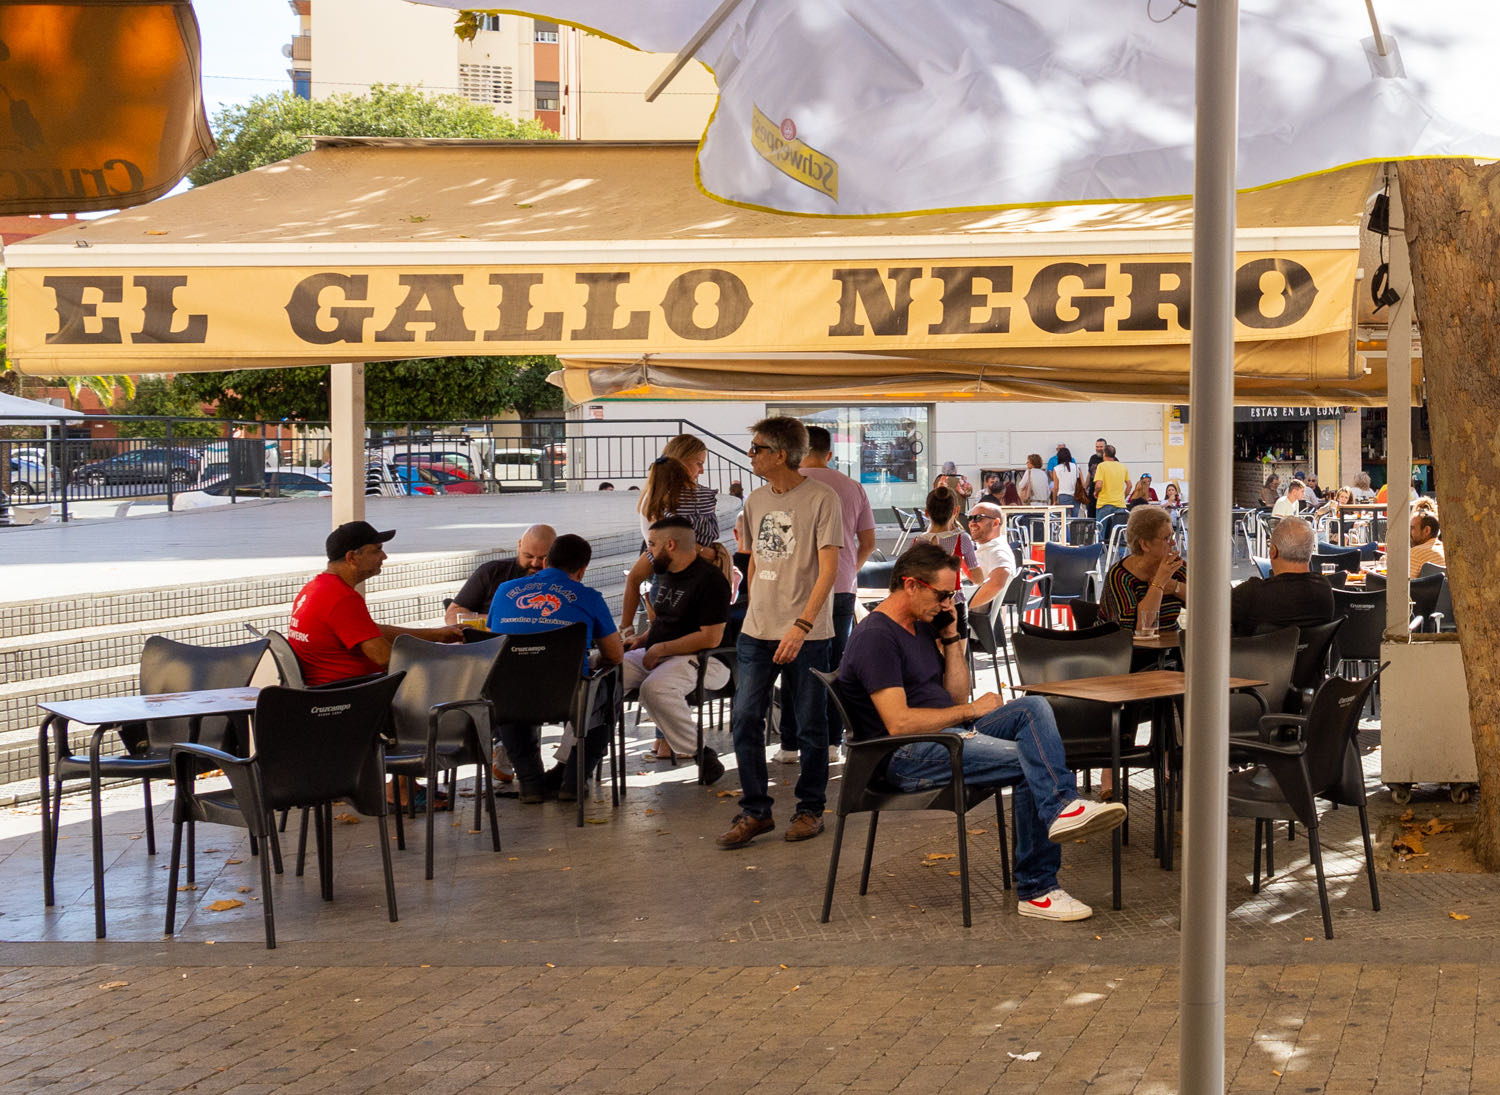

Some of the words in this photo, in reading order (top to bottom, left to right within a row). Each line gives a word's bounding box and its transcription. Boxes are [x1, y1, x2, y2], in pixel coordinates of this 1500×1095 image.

[43, 275, 208, 344] EL
[284, 269, 753, 344] GALLO
[829, 258, 1318, 337] NEGRO
[1250, 407, 1278, 418] ESTAS
[1282, 408, 1294, 417] EN
[1300, 408, 1311, 416] LA
[506, 582, 546, 600] ELOY
[549, 583, 577, 603] MAR
[310, 703, 351, 714] Cruzcampo
